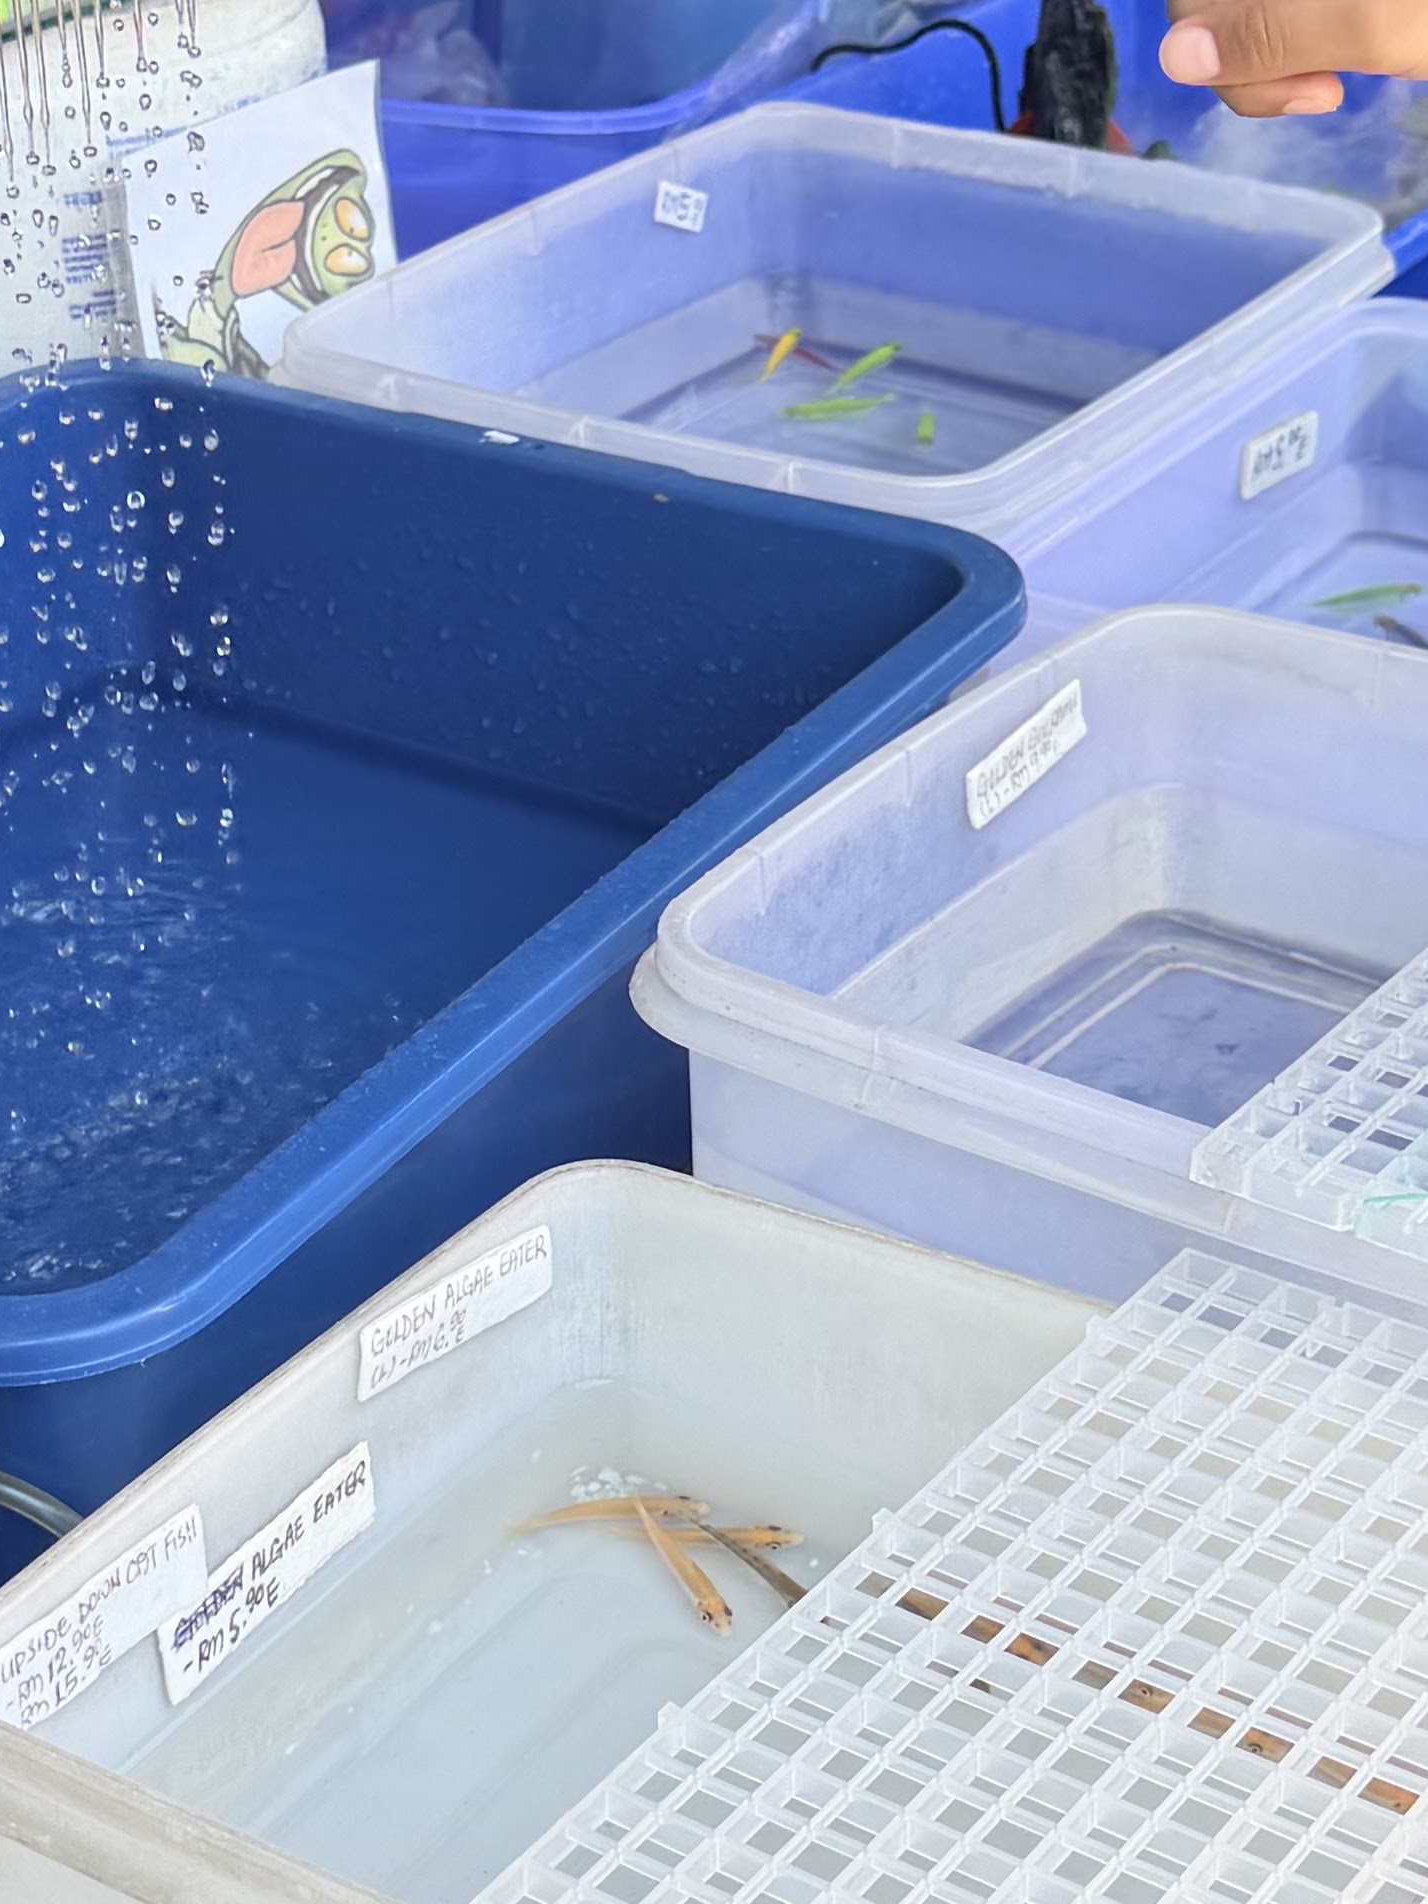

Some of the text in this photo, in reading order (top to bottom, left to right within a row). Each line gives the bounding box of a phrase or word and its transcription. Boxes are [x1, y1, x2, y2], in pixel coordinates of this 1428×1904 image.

[371, 1234, 547, 1355] GOLDEN ALGAE EATER
[252, 1515, 304, 1578] ALGAE
[313, 1460, 365, 1523] EATER
[1, 1516, 196, 1684] UPSIDE DOWN CAT FISH
